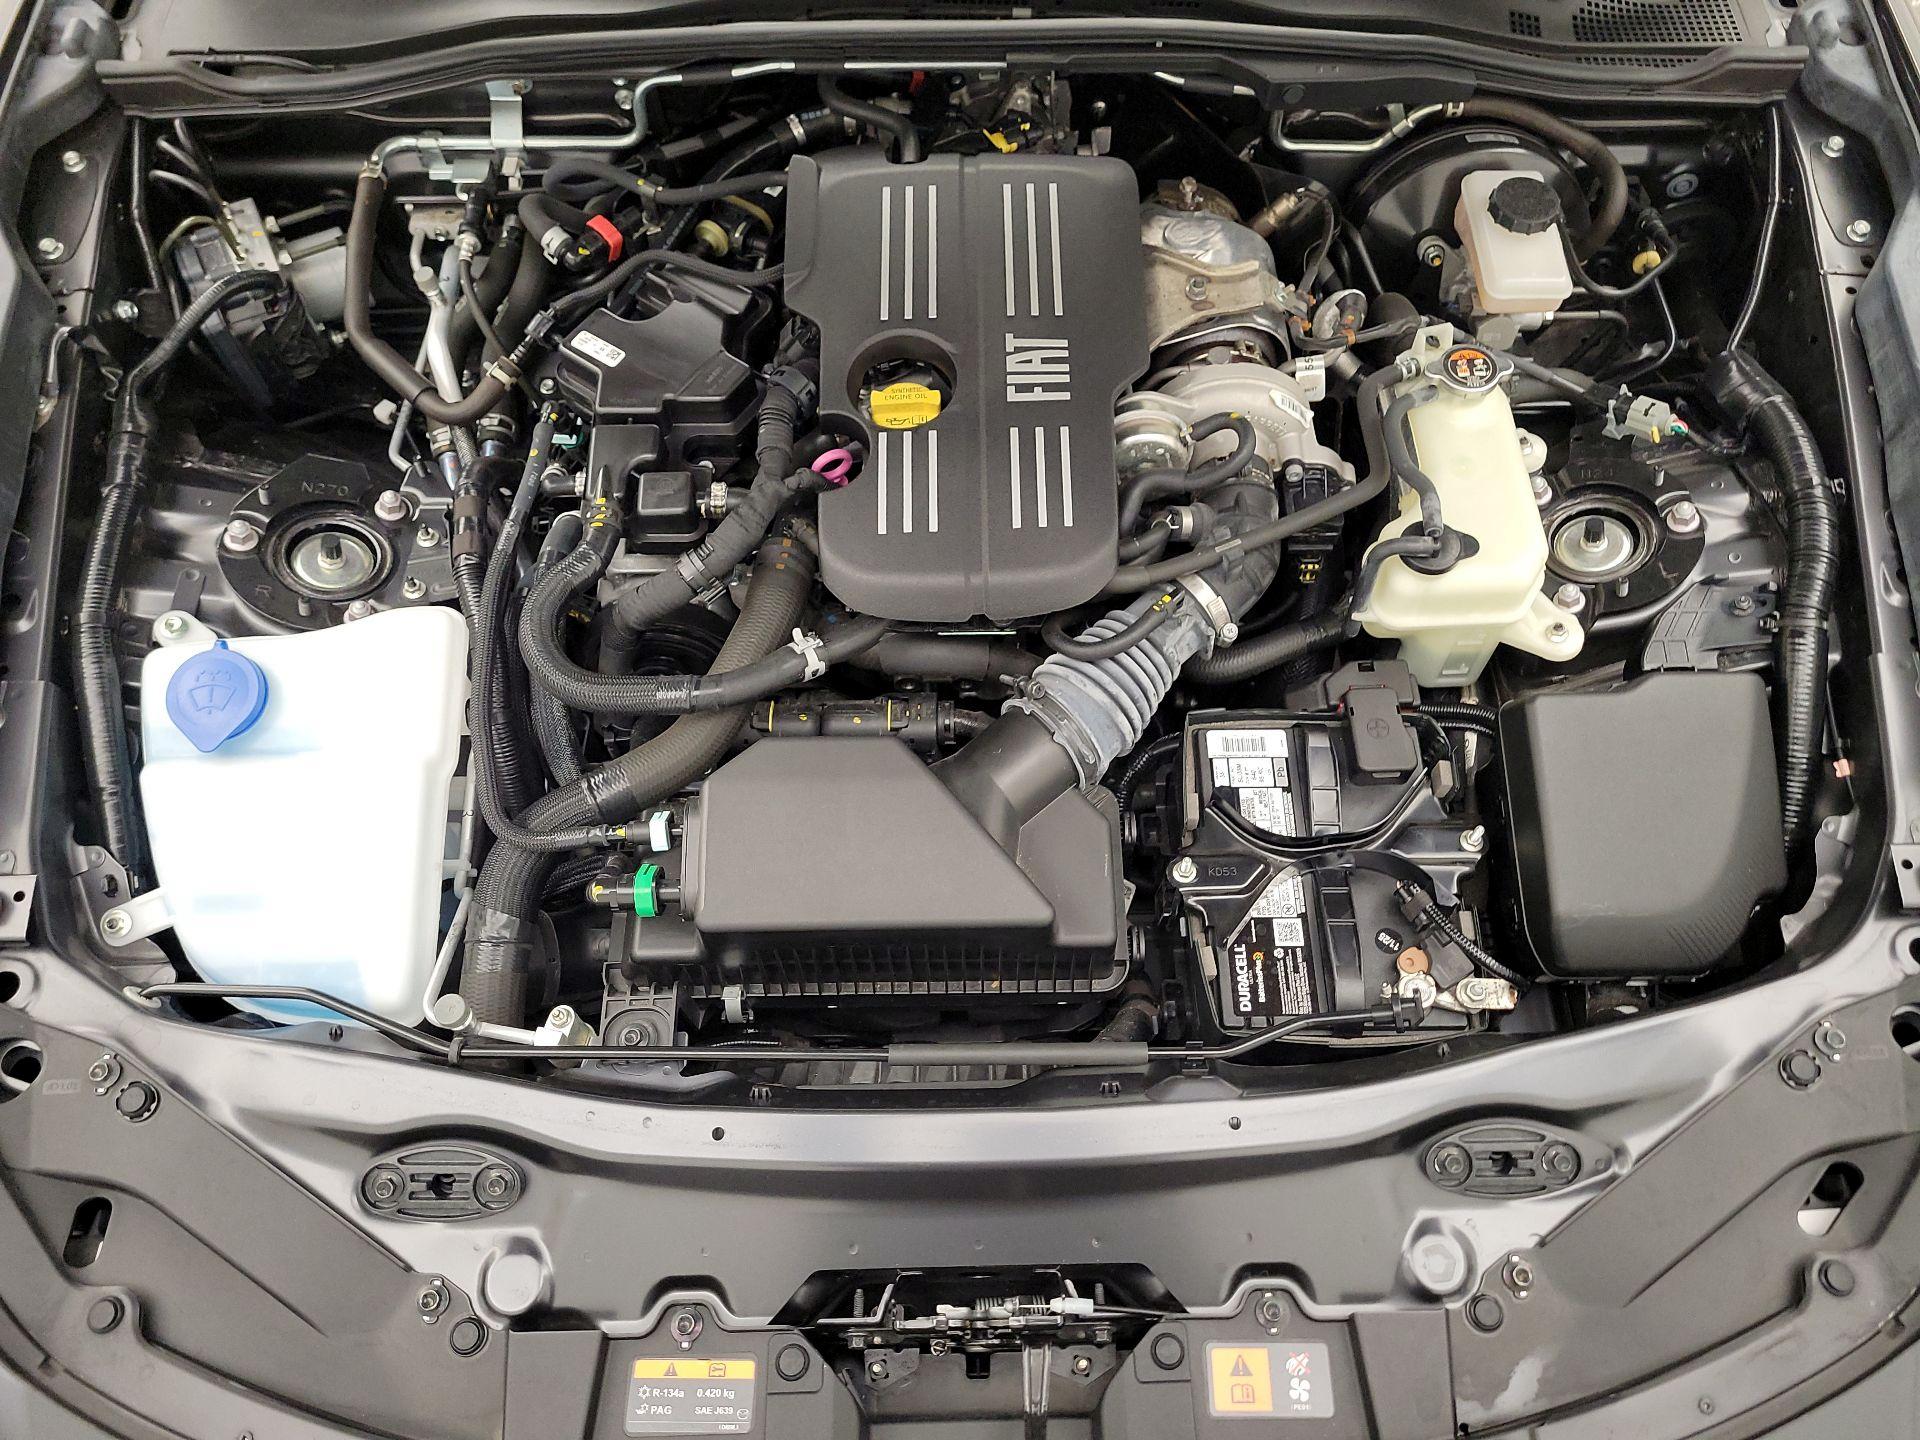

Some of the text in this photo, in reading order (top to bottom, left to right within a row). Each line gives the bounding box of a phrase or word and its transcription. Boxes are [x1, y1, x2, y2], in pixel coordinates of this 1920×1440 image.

[1005, 332, 1071, 402] FIAT
[301, 481, 349, 496] N270
[1277, 766, 1286, 778] Pb
[1208, 867, 1237, 877] KD53
[1378, 932, 1400, 951] 11/25
[1234, 943, 1252, 1012] DURACELL
[652, 1388, 735, 1400] R-134a 0.420 kg
[650, 1405, 734, 1415] PAG SAE J639
